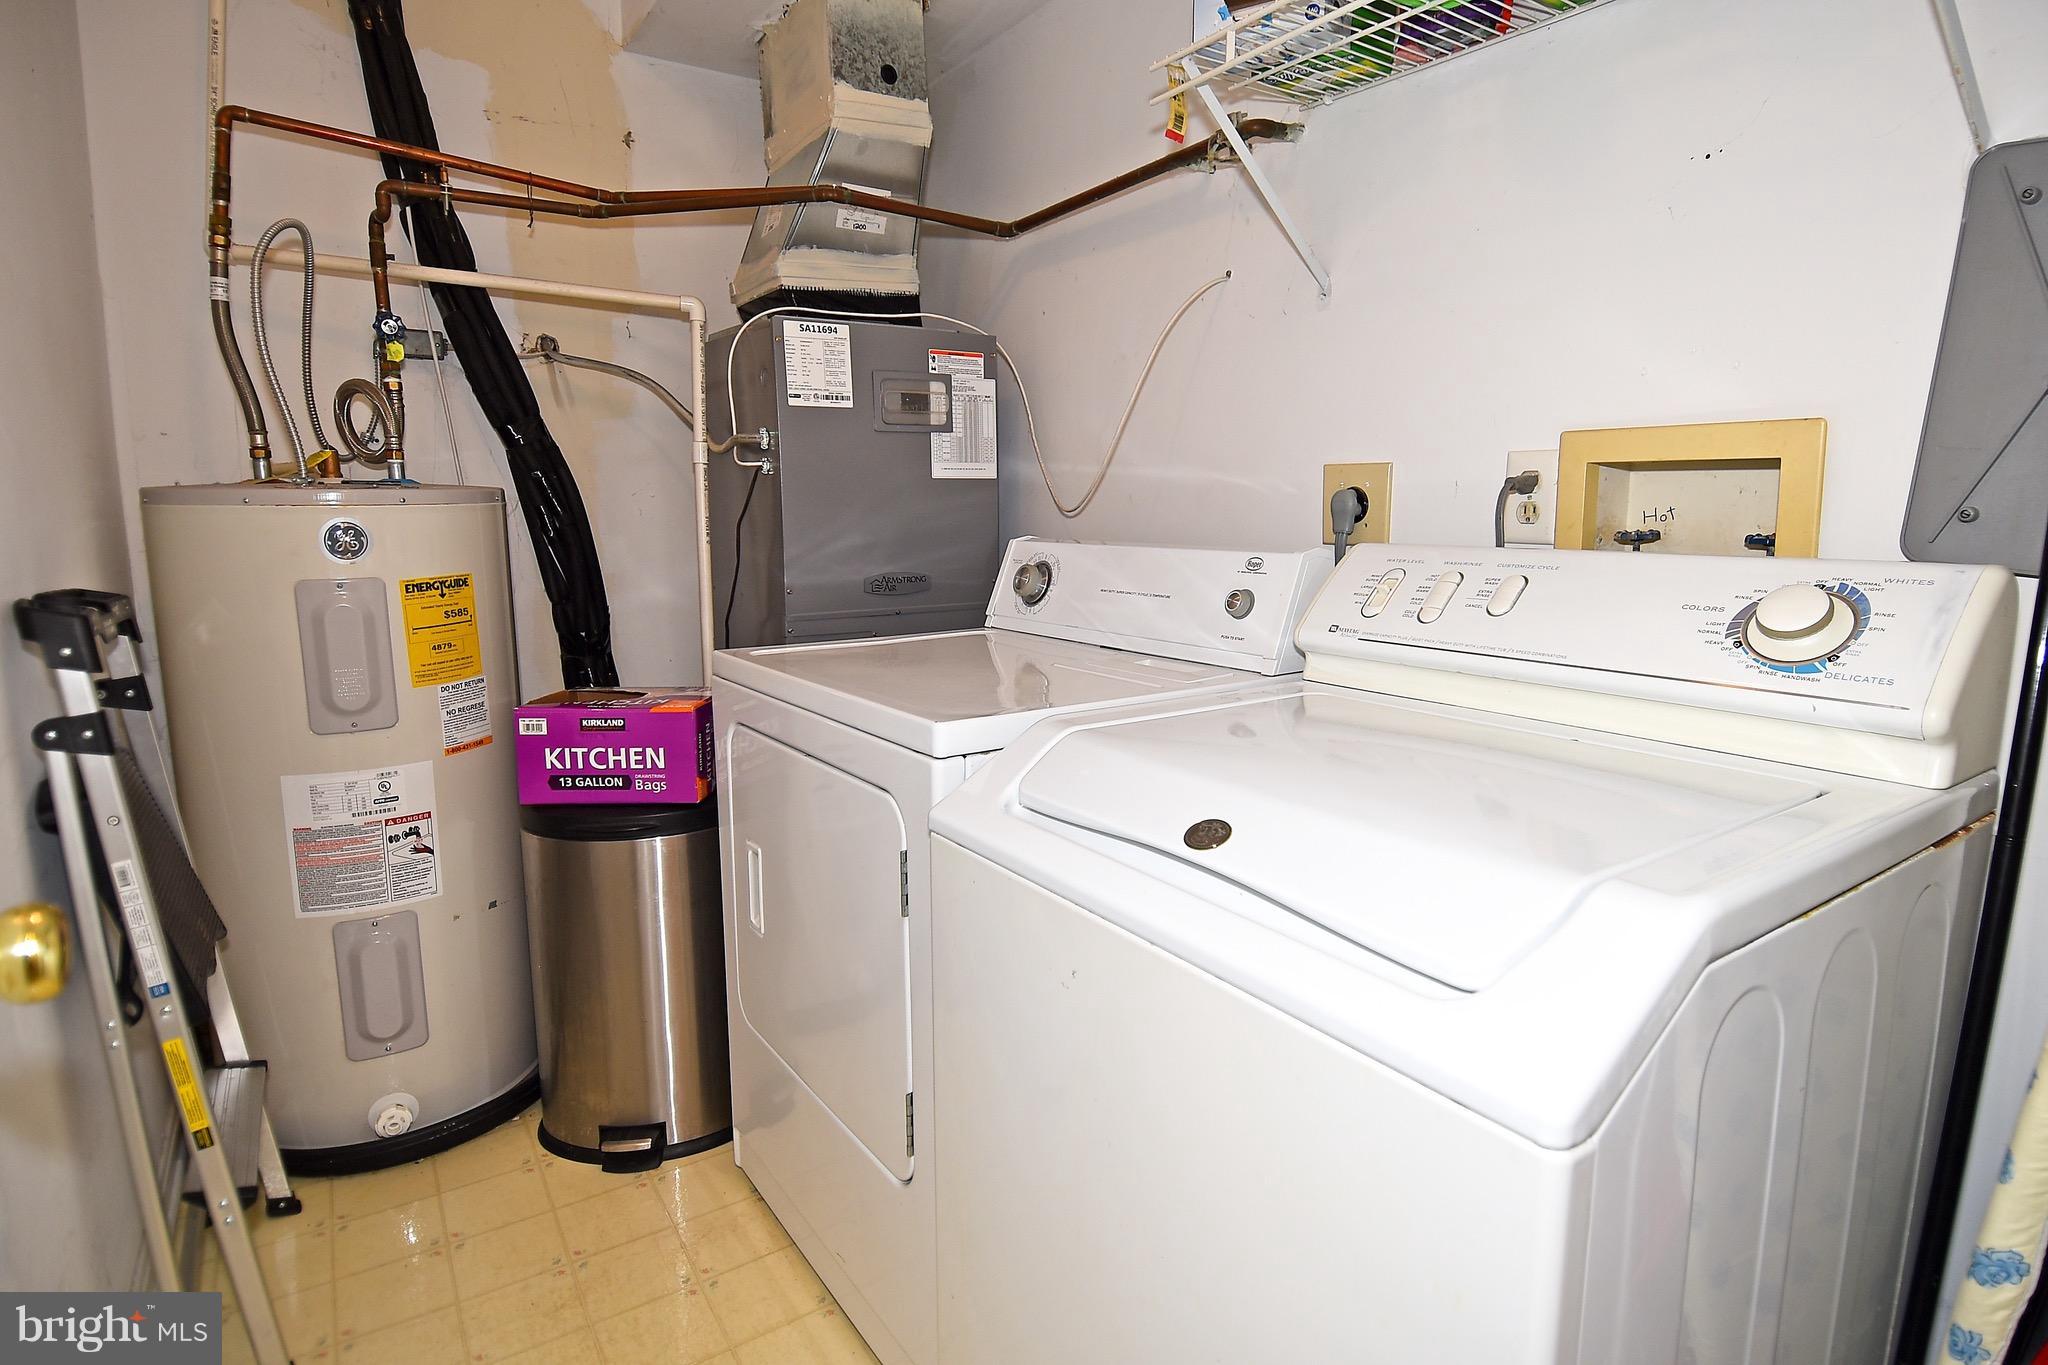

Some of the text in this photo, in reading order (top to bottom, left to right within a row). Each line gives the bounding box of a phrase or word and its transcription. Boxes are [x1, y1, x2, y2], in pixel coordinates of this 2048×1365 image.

[799, 324, 838, 334] SA11694
[1643, 506, 1676, 524] Hot
[1496, 562, 1536, 570] CUSTOMIZE
[880, 576, 927, 584] ARMSTRONG
[1884, 577, 1936, 586] WHITES
[444, 606, 470, 620] $585
[1681, 603, 1725, 612] COLORS
[432, 642, 452, 652] 4879
[1516, 648, 1531, 656] SPEED
[1531, 650, 1568, 660] COMBINATIONS
[1780, 674, 1821, 683] HANDWASH
[1824, 671, 1896, 686] DELICATES
[440, 677, 485, 693] DO NOT RETURN
[446, 700, 486, 716] NO REGRESE
[582, 719, 624, 727] KIRKLAND
[544, 746, 666, 770] KITCHEN
[558, 777, 624, 787] 13 GALLON
[635, 780, 667, 793] Bags
[396, 812, 430, 824] DANGER
